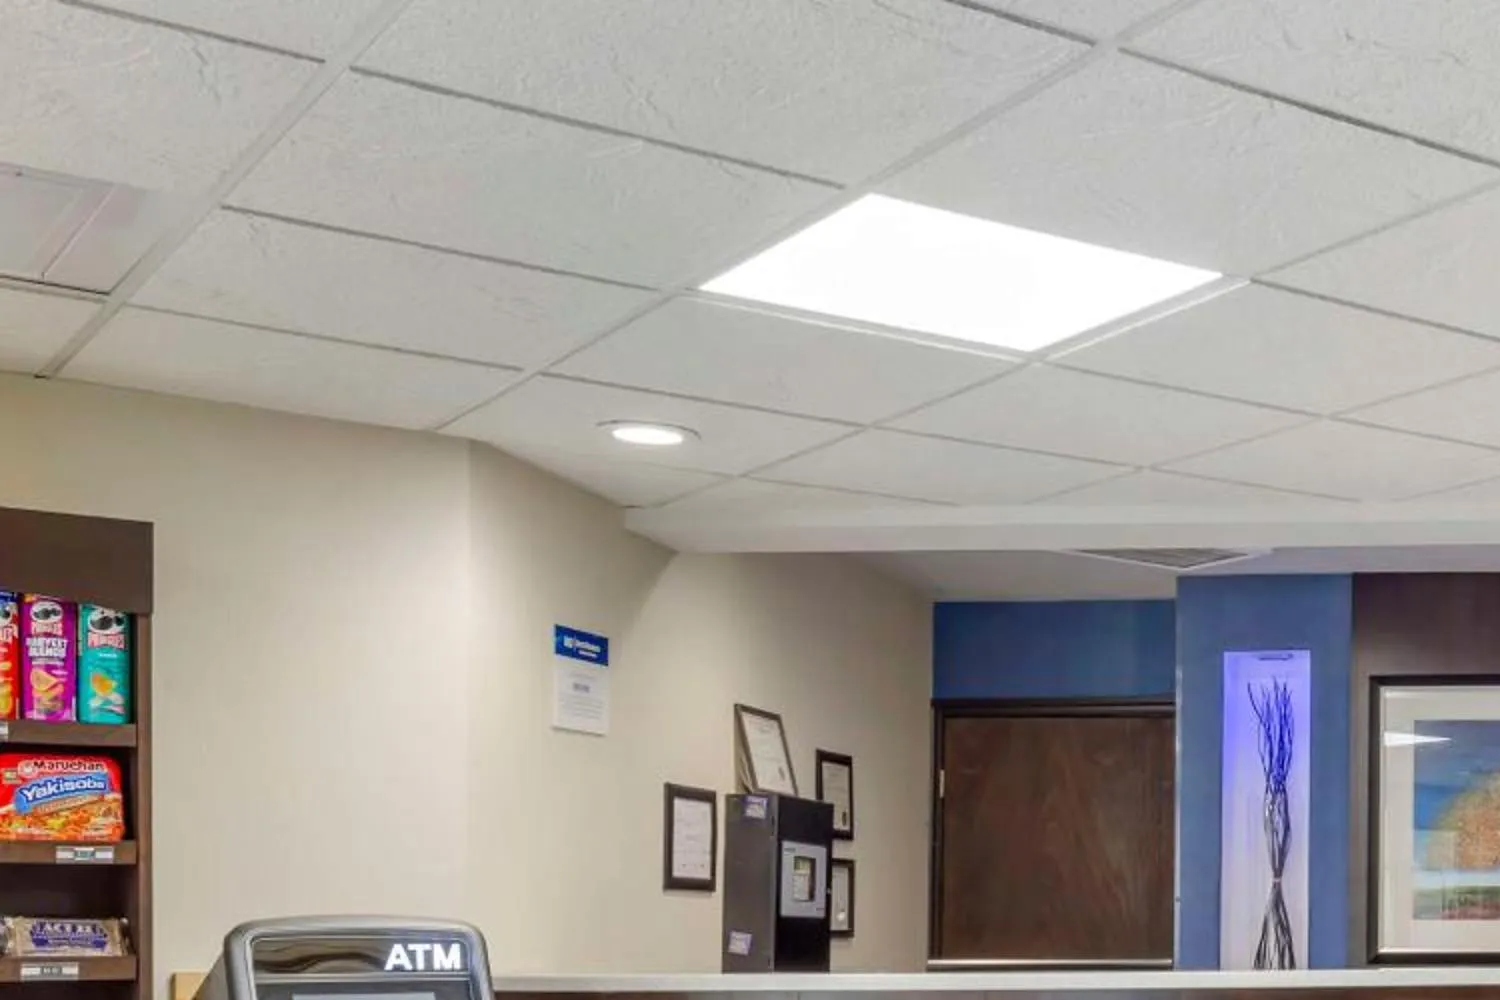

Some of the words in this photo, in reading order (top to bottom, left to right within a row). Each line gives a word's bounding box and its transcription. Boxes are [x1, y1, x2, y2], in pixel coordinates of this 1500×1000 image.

[33, 760, 105, 771] Maruchan
[20, 777, 105, 802] Yakisoba
[384, 943, 461, 971] ATM
